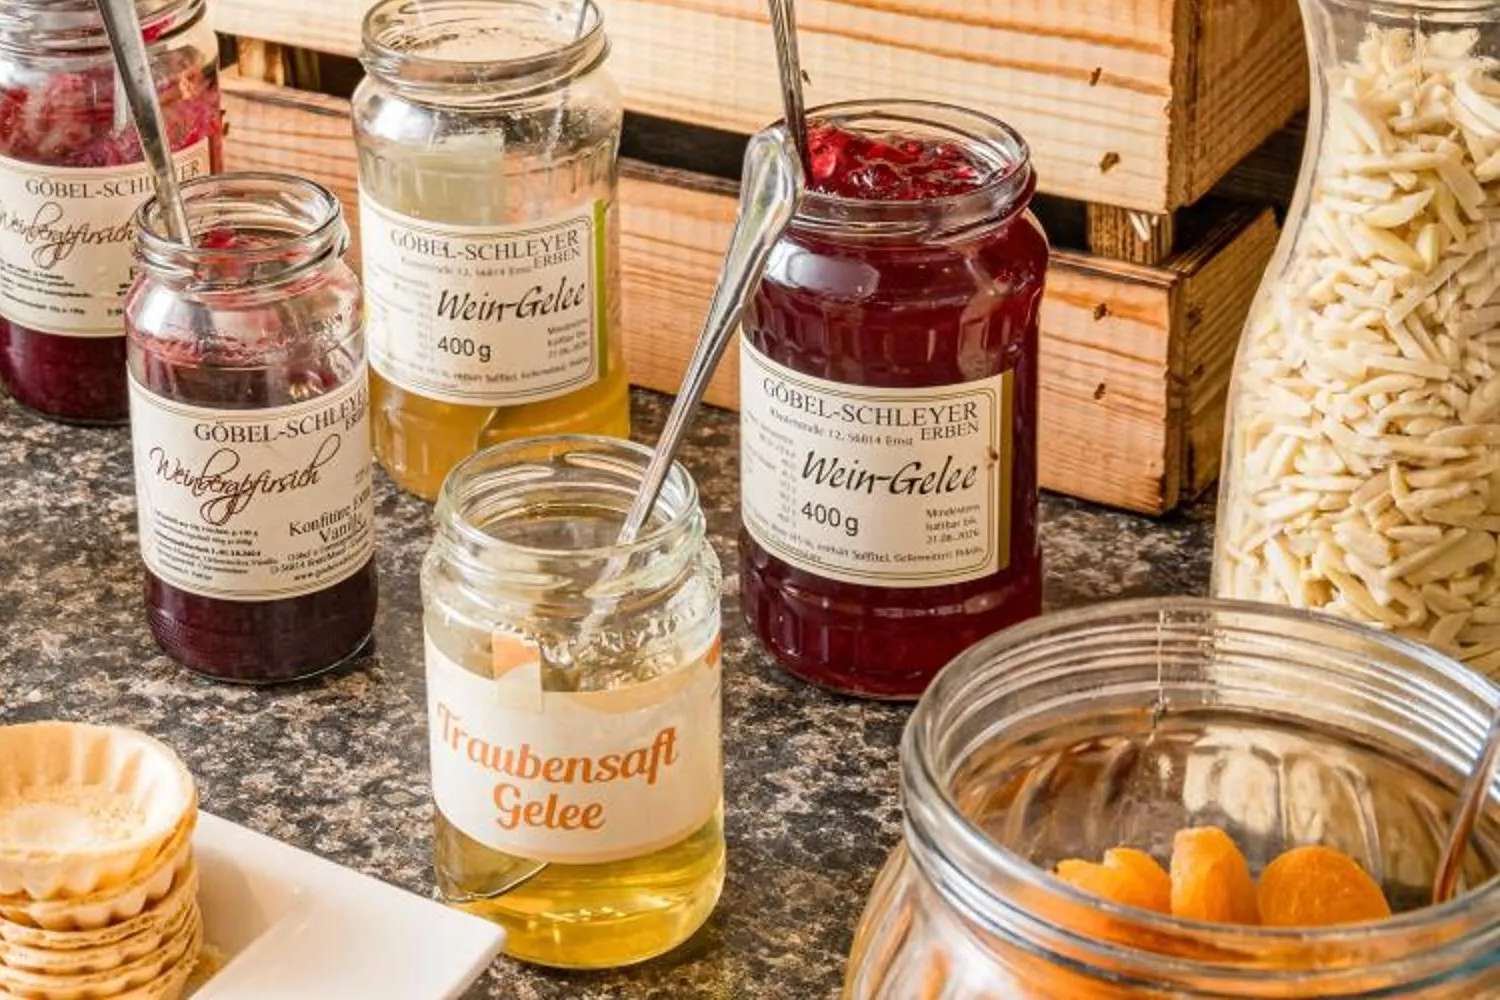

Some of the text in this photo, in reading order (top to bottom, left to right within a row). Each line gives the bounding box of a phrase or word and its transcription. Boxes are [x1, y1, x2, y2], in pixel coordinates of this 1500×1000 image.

[390, 228, 580, 261] GÖBEL-SCHLEYER
[532, 246, 582, 269] ERBEN
[437, 275, 585, 323] Wein-Gelee
[763, 377, 978, 427] GÖBEL-SCHLEYER
[921, 421, 980, 442] ERBEN
[150, 433, 341, 526] Weinbergpfirsich
[801, 450, 978, 497] Wein-Gelee
[437, 702, 679, 785] Traubensaft
[493, 781, 607, 831] Gelee
